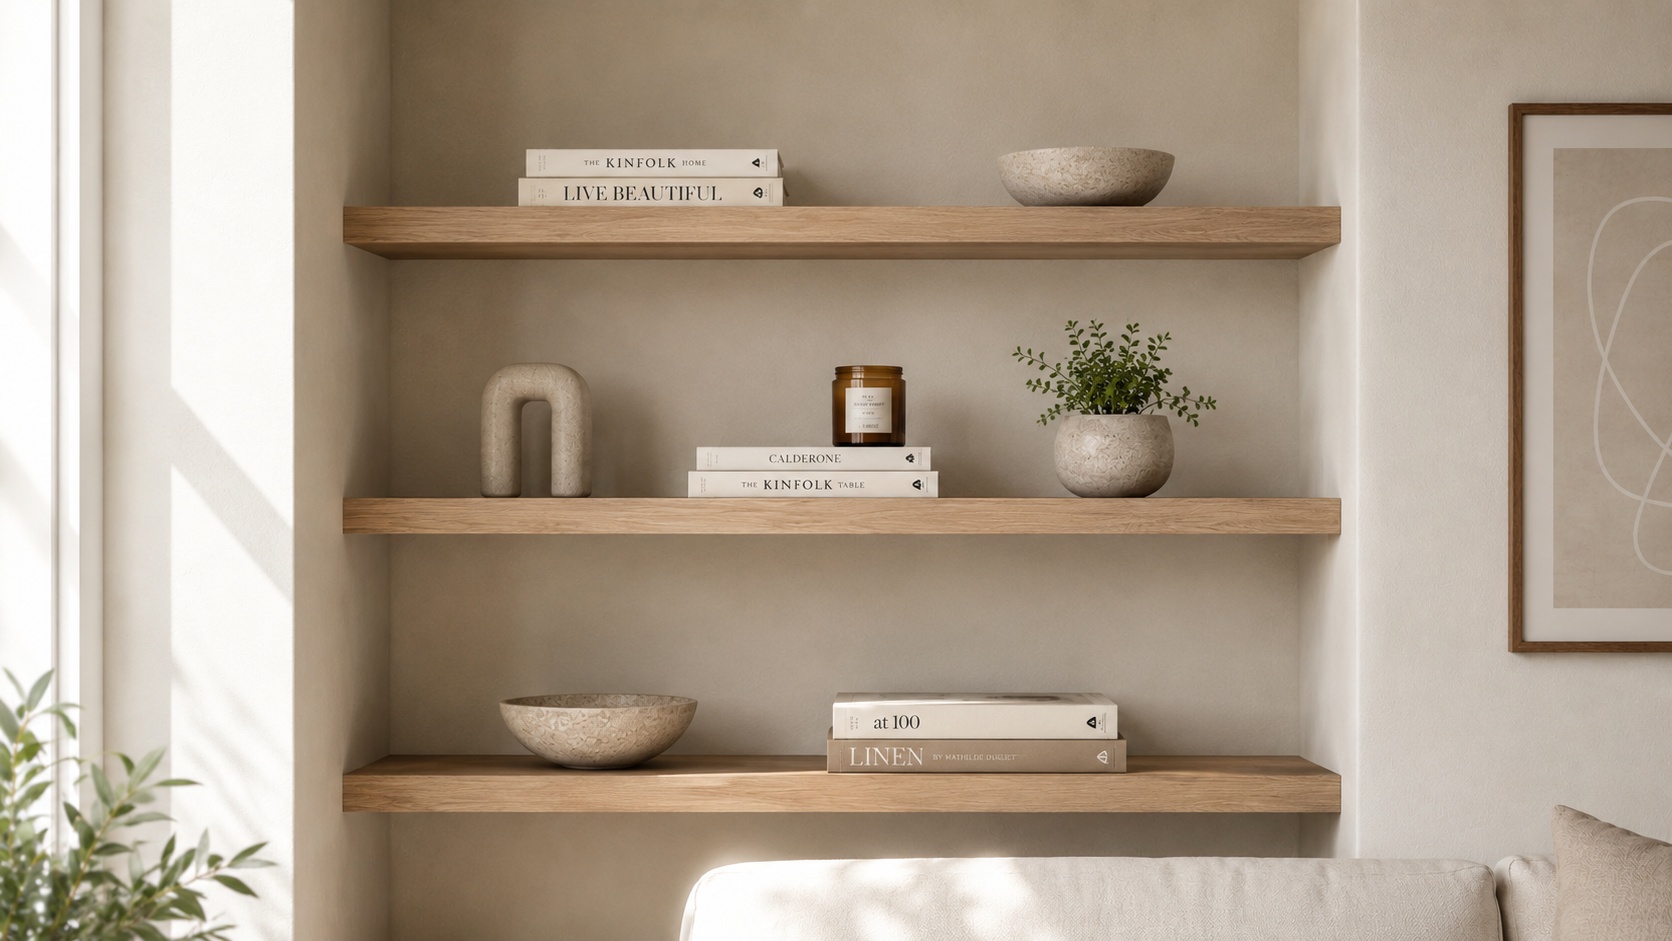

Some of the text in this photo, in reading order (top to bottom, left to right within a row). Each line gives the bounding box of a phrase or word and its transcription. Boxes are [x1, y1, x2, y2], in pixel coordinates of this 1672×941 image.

[606, 157, 676, 168] KINFOLK
[682, 159, 707, 167] HOME
[563, 185, 608, 201] LIVE
[613, 185, 723, 201] BEAUTIFUL
[769, 453, 842, 464] CALDERONE
[763, 479, 833, 490] KINFOLK
[838, 481, 865, 489] TABLE
[873, 716, 889, 730] at
[892, 714, 920, 730] 100
[849, 746, 923, 766] LINEN
[932, 753, 944, 761] BY
